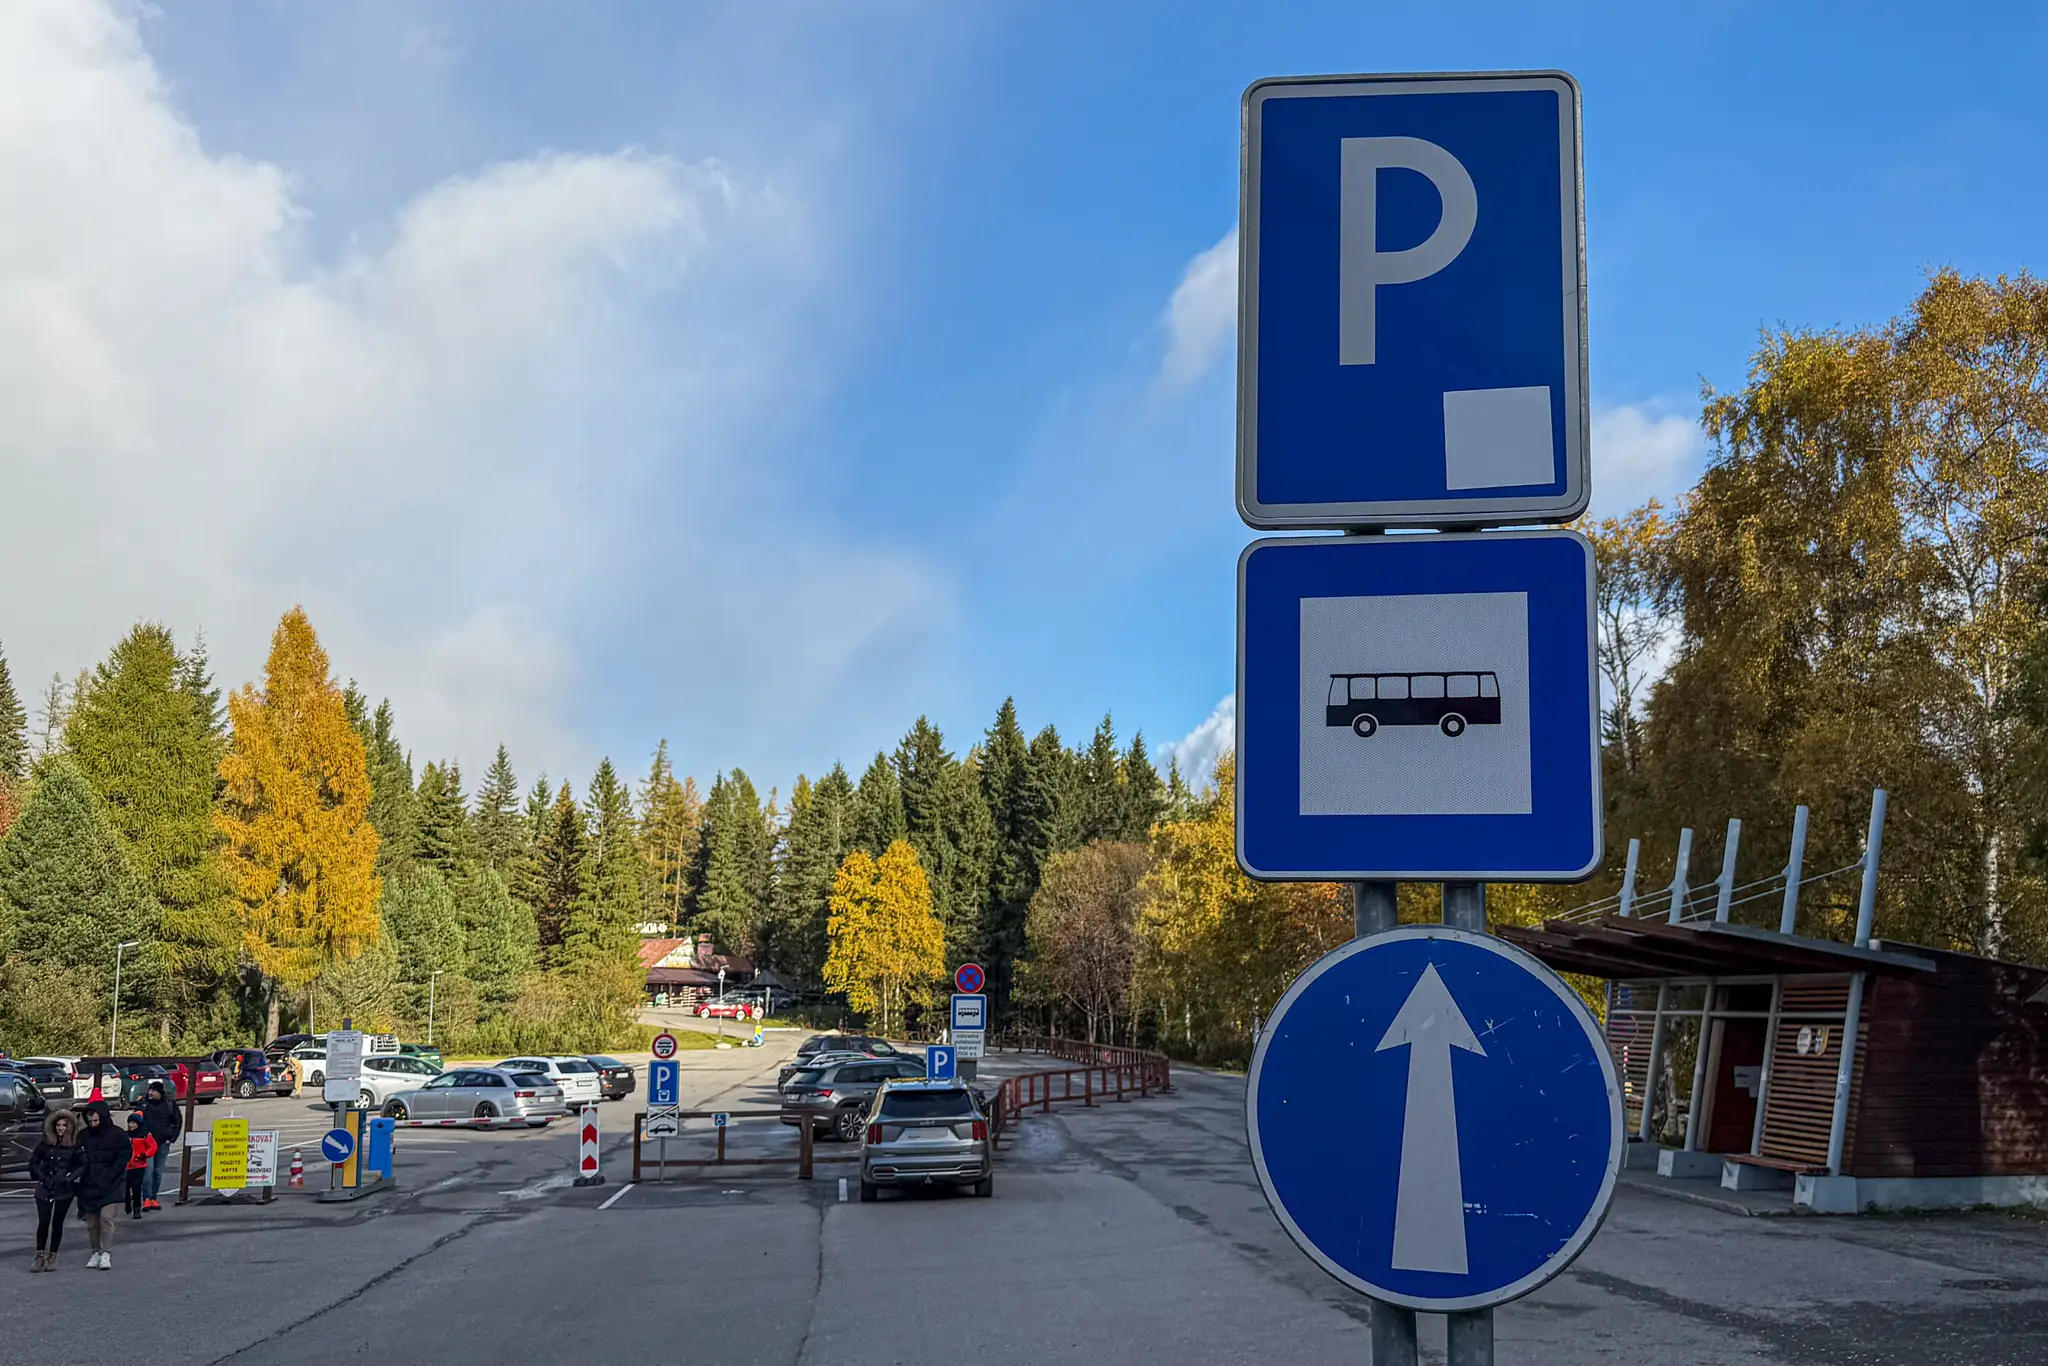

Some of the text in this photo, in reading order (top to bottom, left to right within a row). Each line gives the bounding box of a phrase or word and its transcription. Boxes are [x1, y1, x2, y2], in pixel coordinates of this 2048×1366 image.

[1339, 135, 1478, 366] P
[935, 1050, 948, 1074] P
[657, 1066, 670, 1090] P
